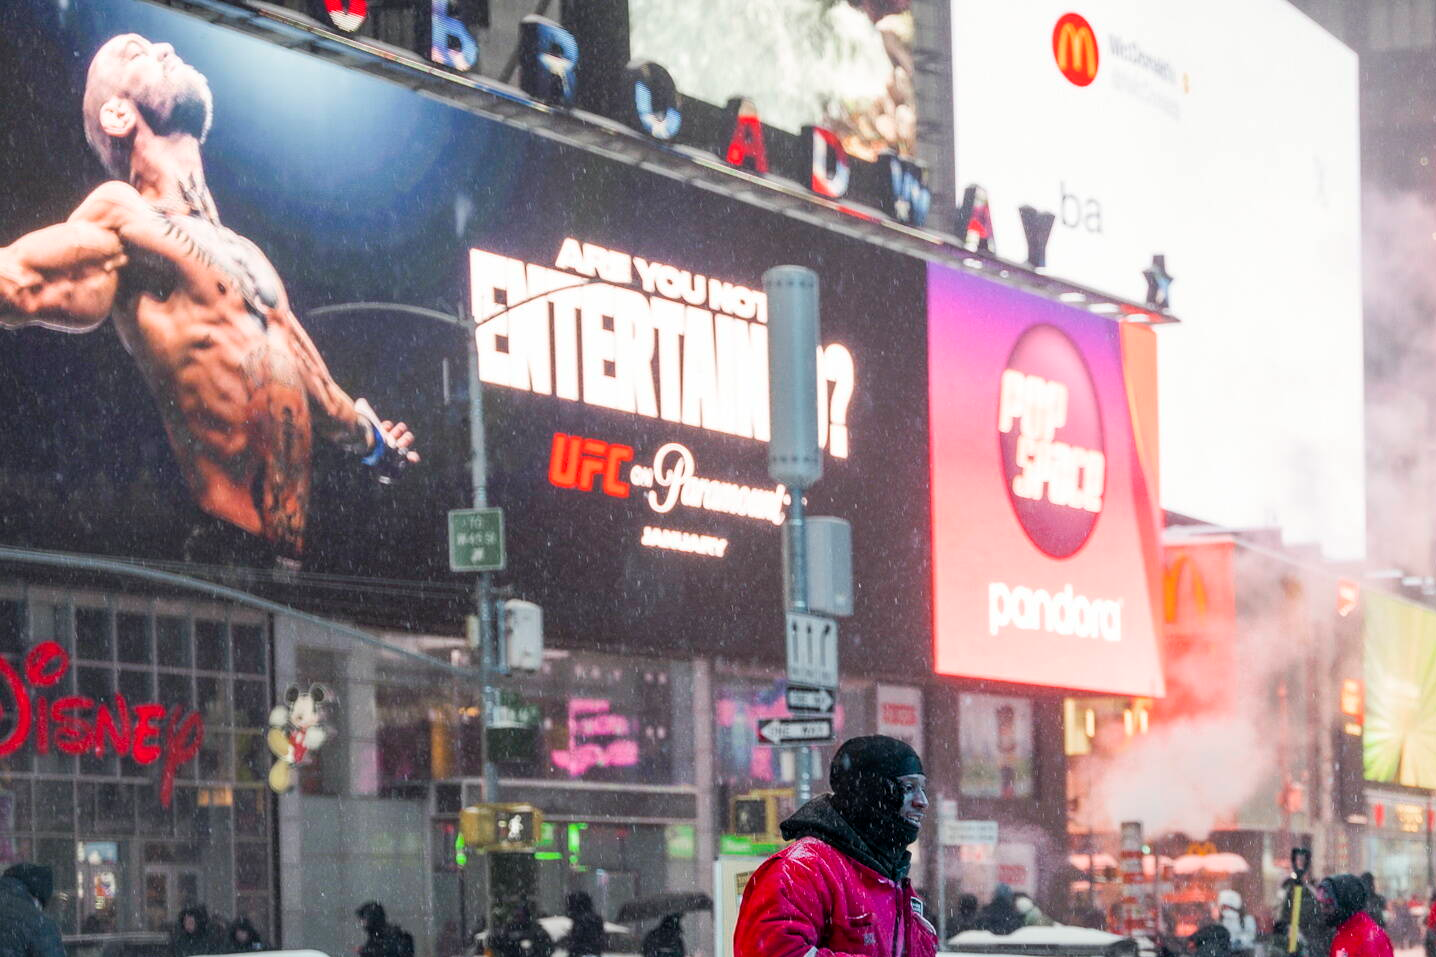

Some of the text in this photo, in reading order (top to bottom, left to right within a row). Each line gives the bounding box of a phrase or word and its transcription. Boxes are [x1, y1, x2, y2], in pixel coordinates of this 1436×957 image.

[555, 237, 768, 324] ARE YOU NOT
[469, 247, 855, 460] ENTERTAIN?
[549, 432, 634, 499] UFC
[648, 441, 808, 526] Paramount
[640, 526, 728, 559] JANUARY
[988, 581, 1124, 642] pandora
